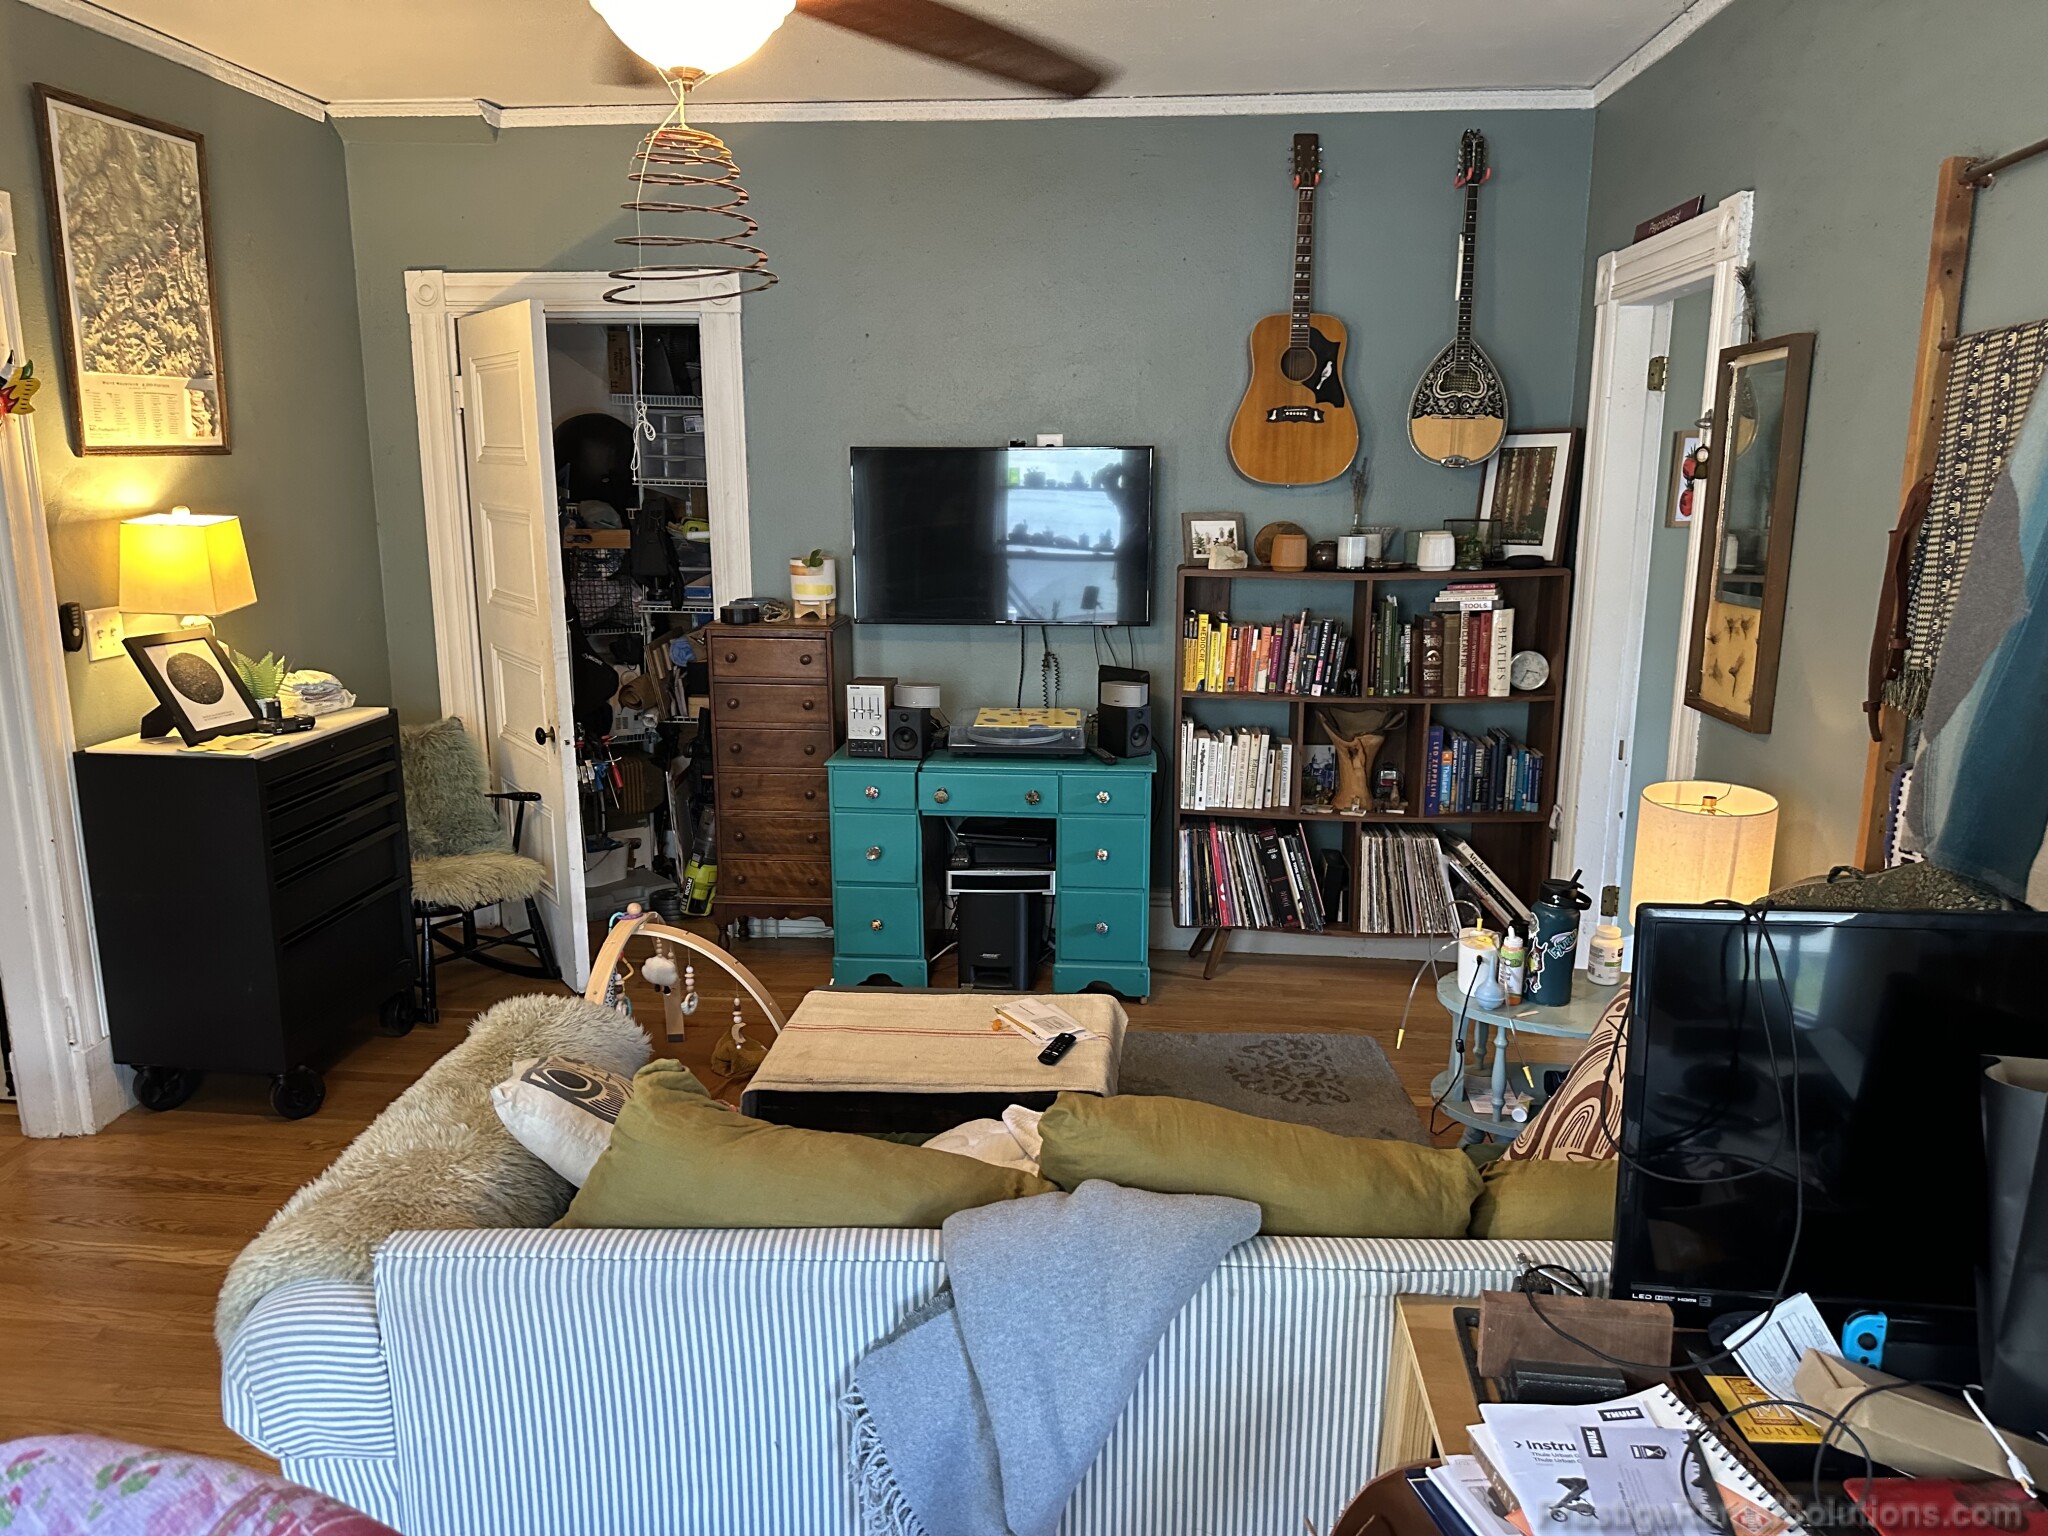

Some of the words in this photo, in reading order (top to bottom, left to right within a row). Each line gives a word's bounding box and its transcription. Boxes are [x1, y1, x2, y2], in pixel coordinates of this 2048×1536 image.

[1649, 210, 1681, 234] Psychologist
[1498, 627, 1507, 680] BEATLES
[1475, 748, 1484, 774] KEROUAC
[1469, 853, 1490, 875] Angkor
[684, 877, 693, 896] RYOBI
[1603, 1409, 1639, 1419] THULE
[1526, 1440, 1576, 1452] Instru
[1586, 1430, 1602, 1456] THULE
